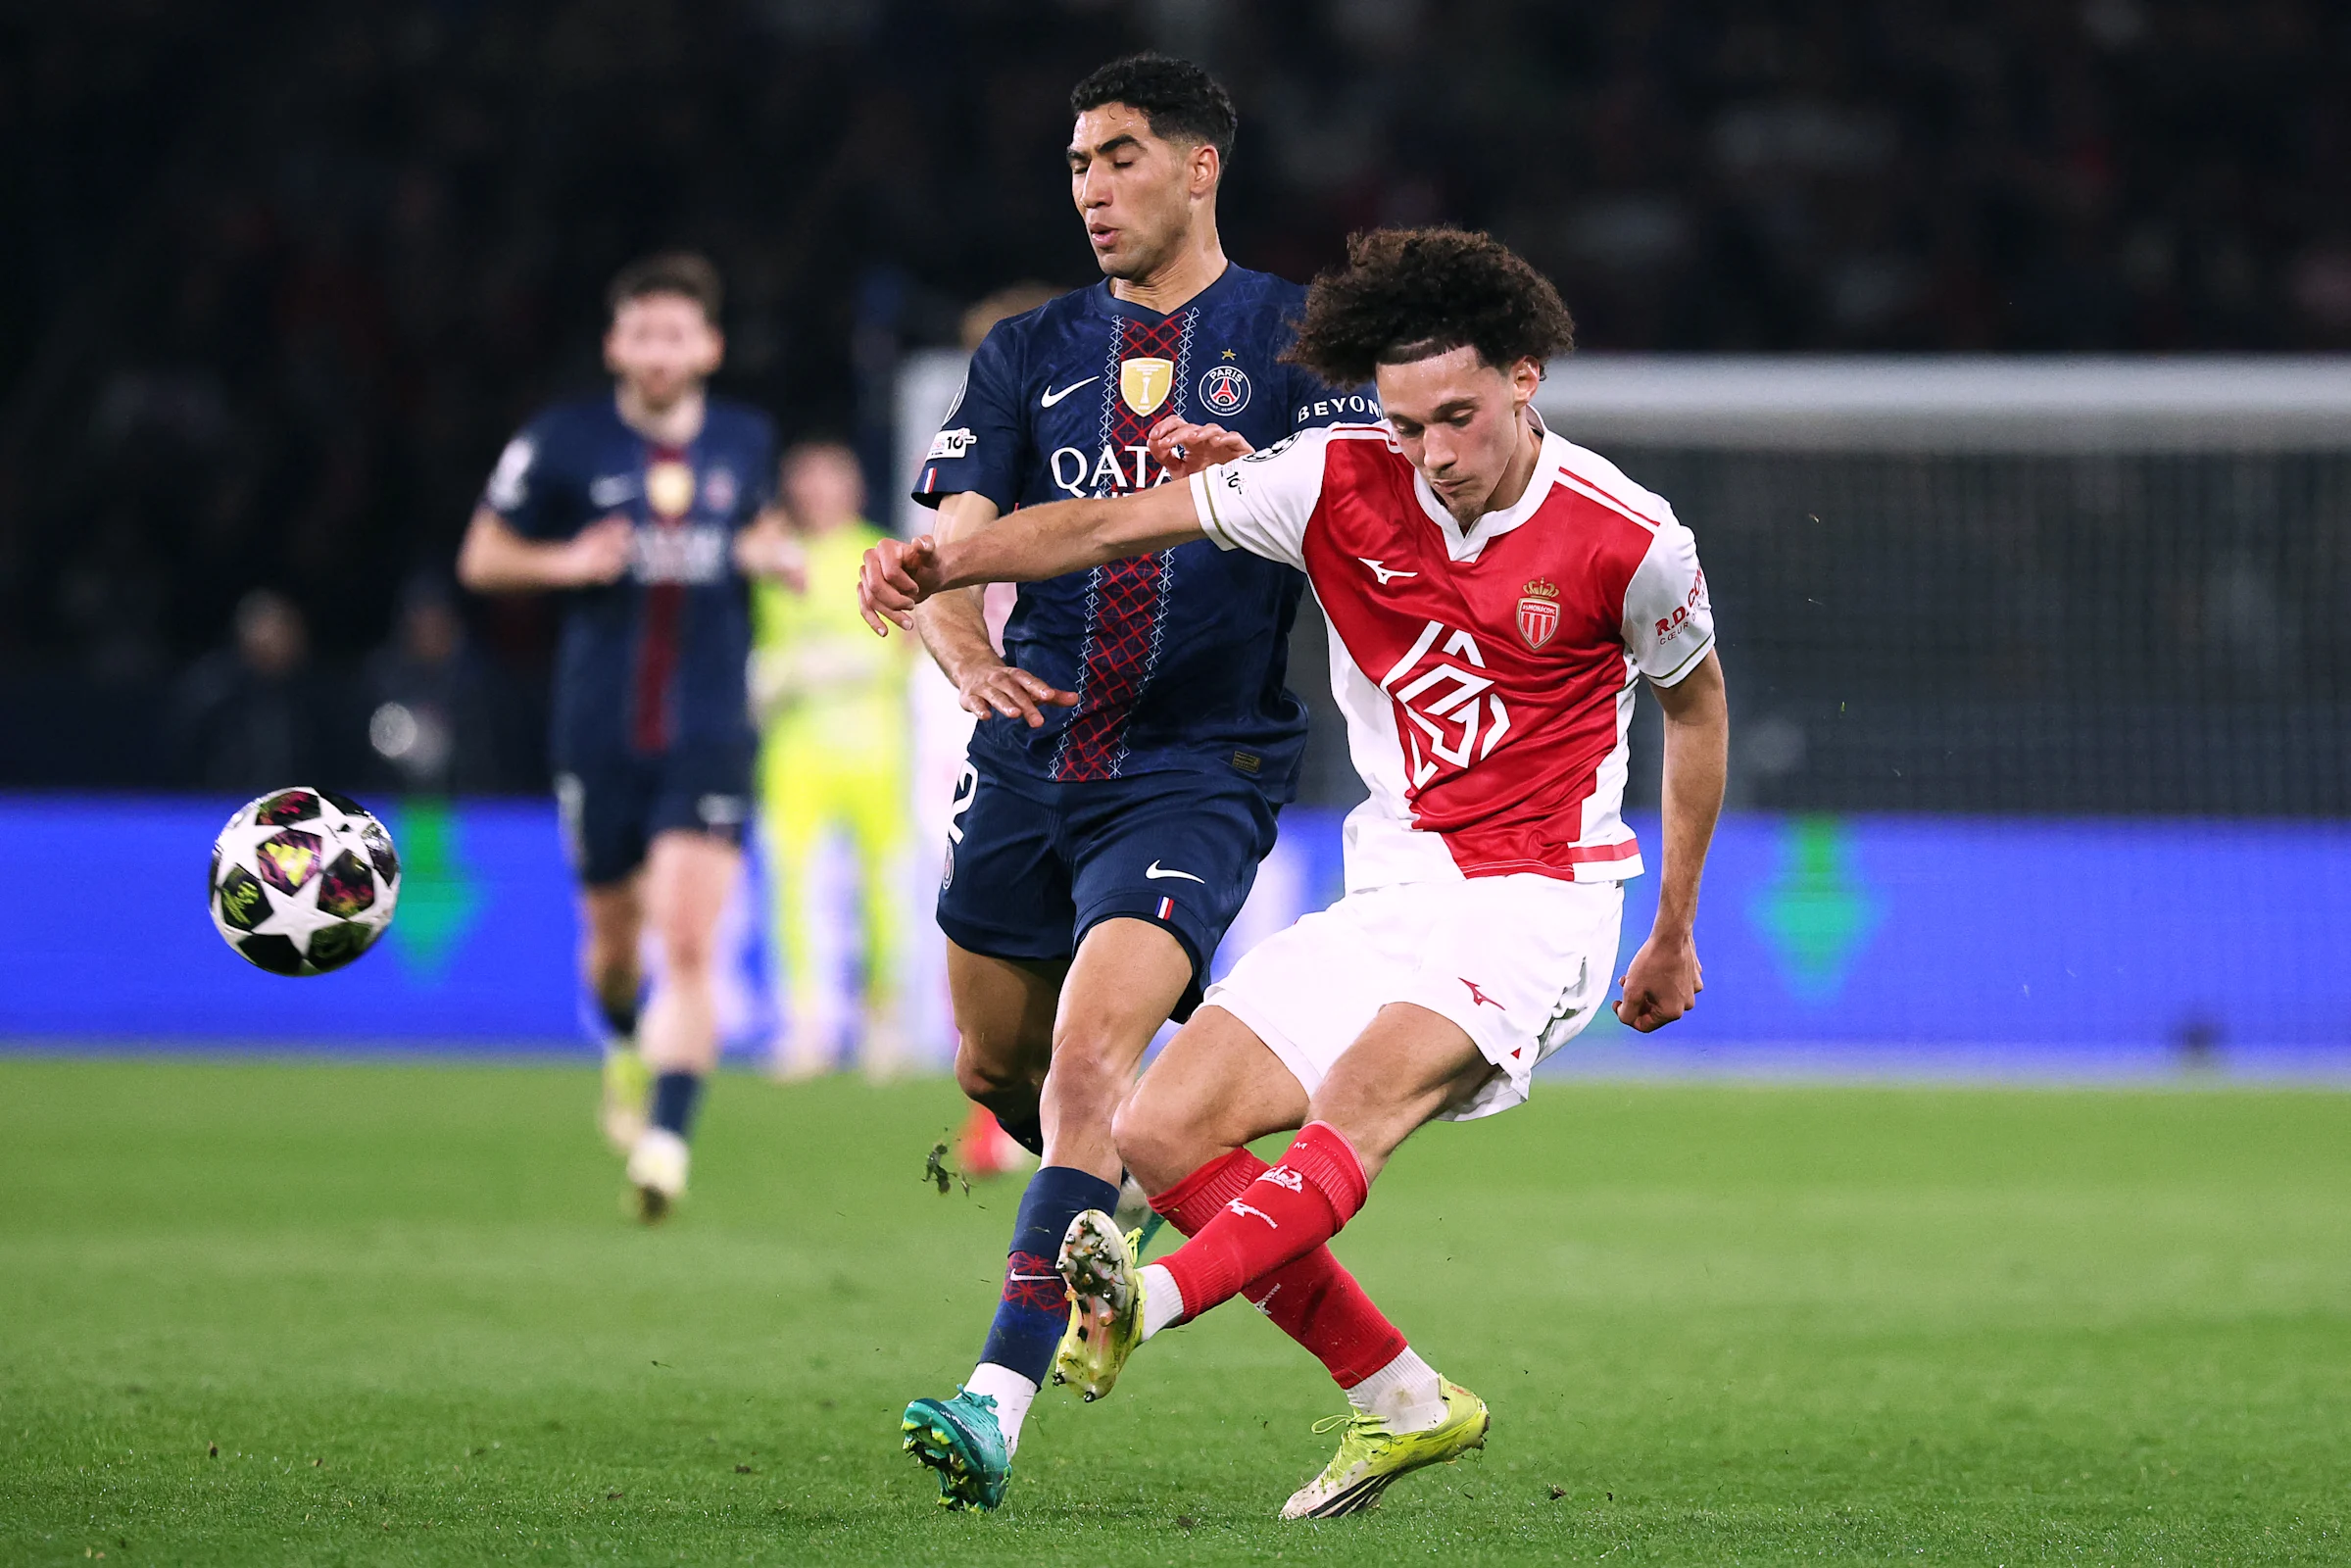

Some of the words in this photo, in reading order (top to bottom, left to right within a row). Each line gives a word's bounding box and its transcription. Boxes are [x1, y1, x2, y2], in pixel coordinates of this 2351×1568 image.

[1209, 368, 1244, 383] PARIS
[1298, 395, 1384, 423] BEYON
[1654, 606, 1690, 637] R.D.
